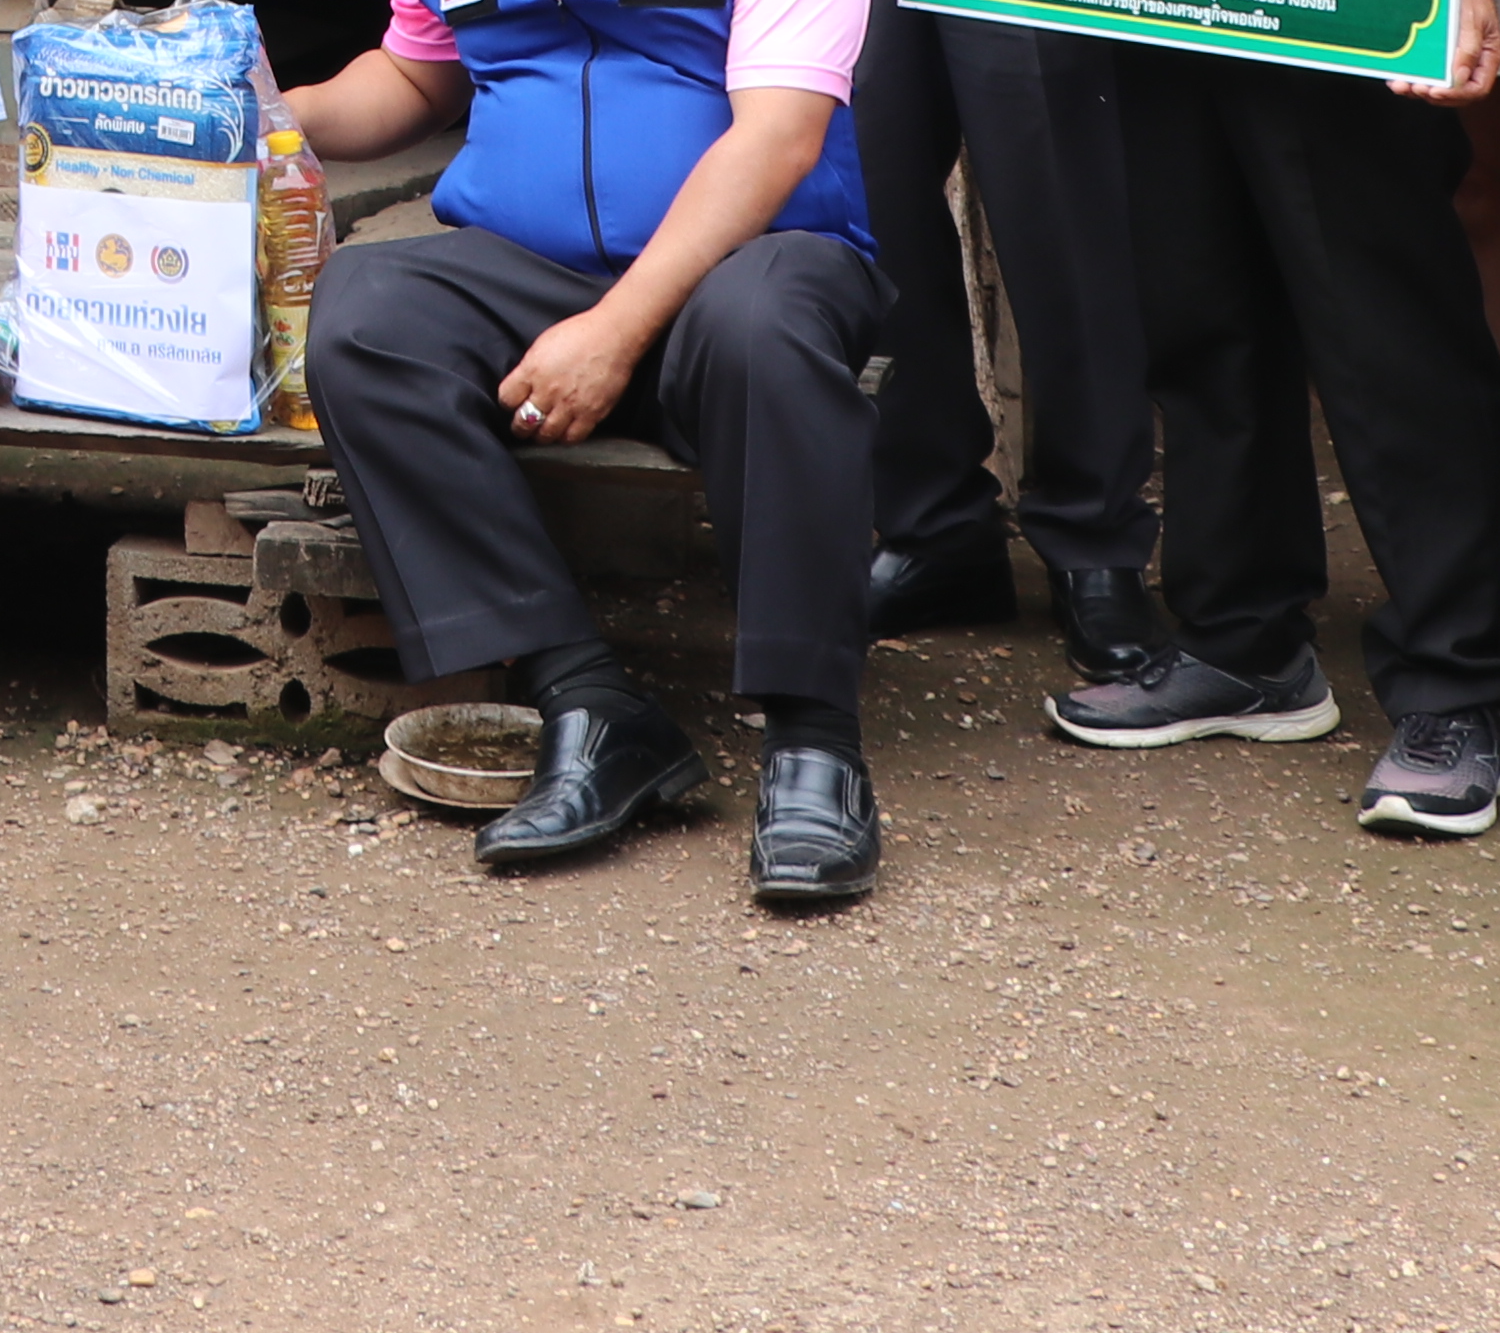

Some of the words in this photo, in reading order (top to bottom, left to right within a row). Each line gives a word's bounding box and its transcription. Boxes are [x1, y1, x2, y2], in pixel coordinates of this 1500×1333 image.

[55, 158, 101, 177] Healthy
[111, 164, 136, 180] Non
[138, 168, 195, 186] Chemical
